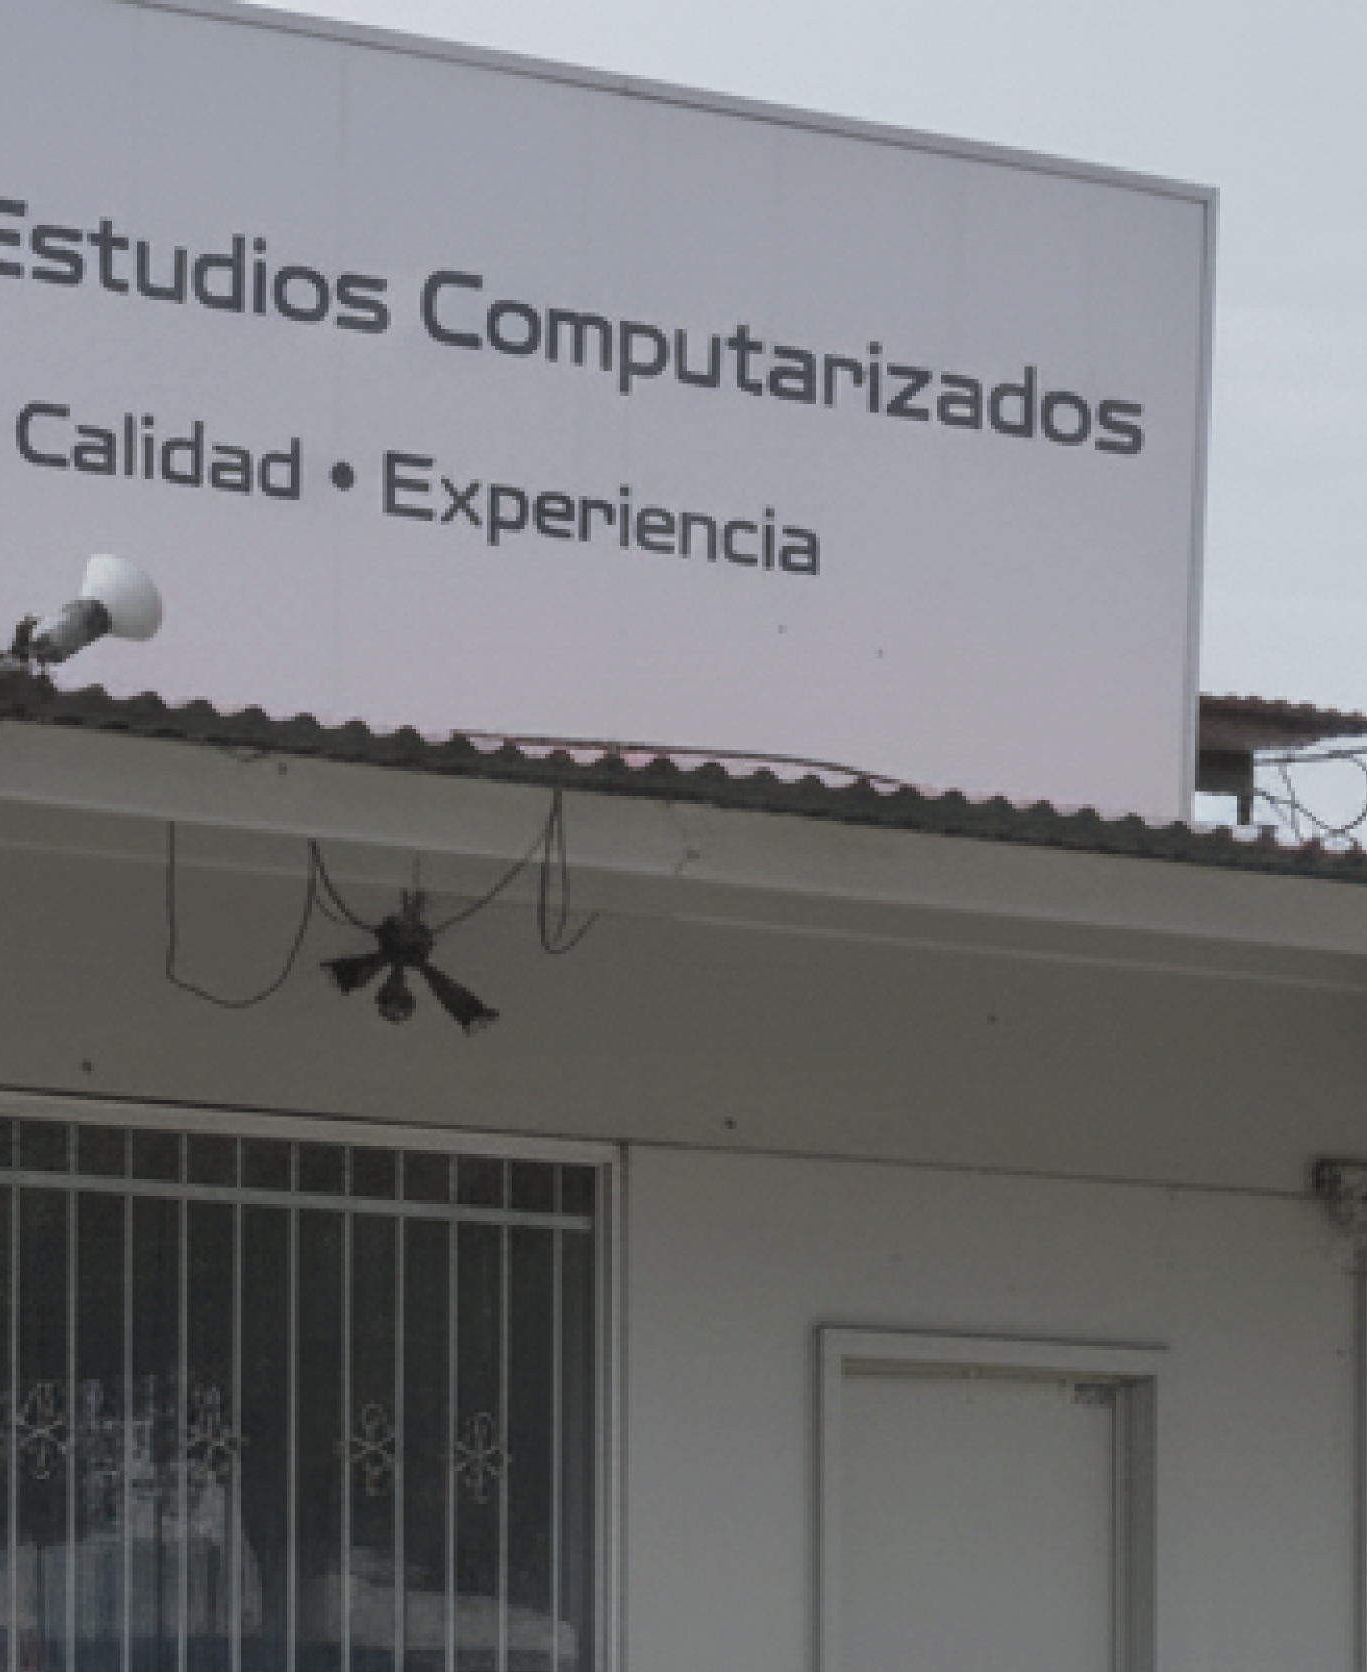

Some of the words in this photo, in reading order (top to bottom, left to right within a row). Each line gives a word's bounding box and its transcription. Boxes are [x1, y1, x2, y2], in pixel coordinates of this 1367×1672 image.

[419, 270, 1143, 456] Computarizados
[15, 403, 301, 501] Calidad
[382, 449, 821, 576] Experiencia
